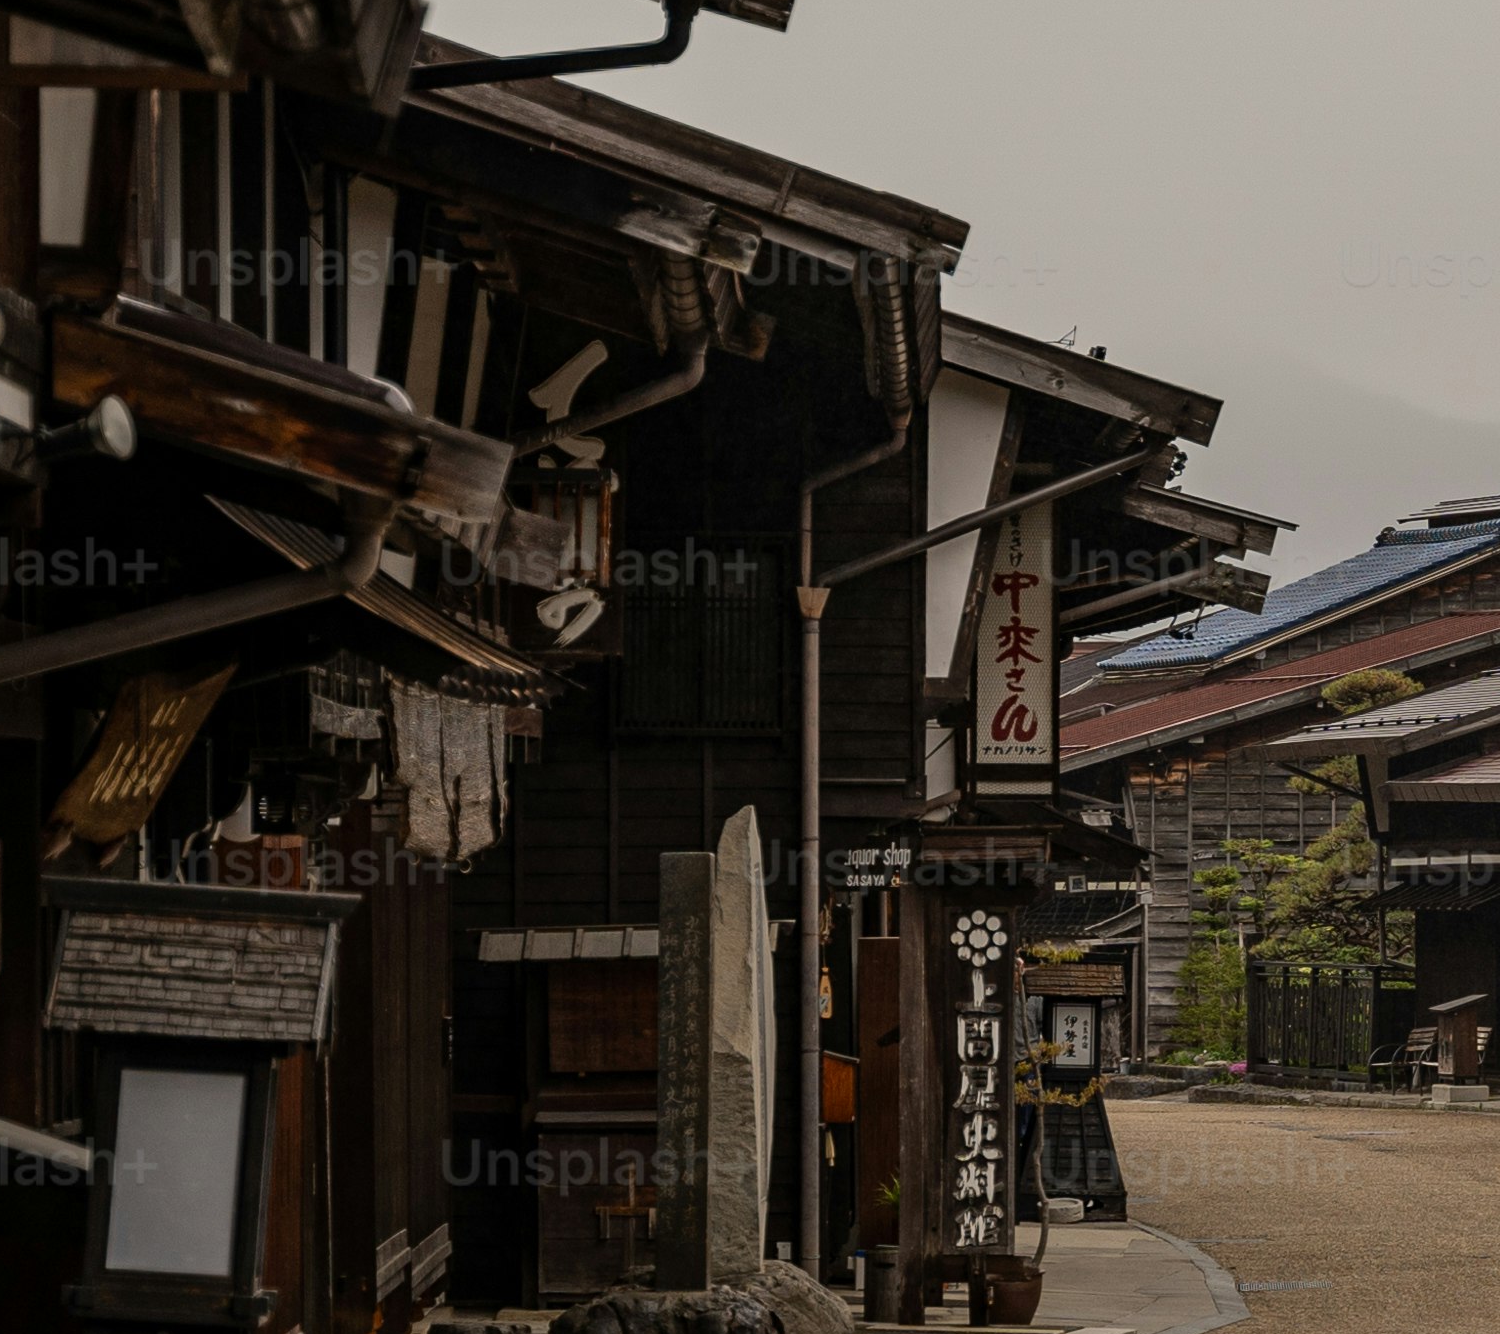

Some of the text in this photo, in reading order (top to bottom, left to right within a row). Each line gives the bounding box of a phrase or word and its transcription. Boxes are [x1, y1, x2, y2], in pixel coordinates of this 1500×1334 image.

[982, 745, 1047, 756] ナカノリサン
[882, 841, 911, 869] shop
[846, 874, 886, 887] SASAYA
[1062, 1014, 1079, 1058] 伊勢屋
[952, 968, 1004, 1248] 上問屋史料館
